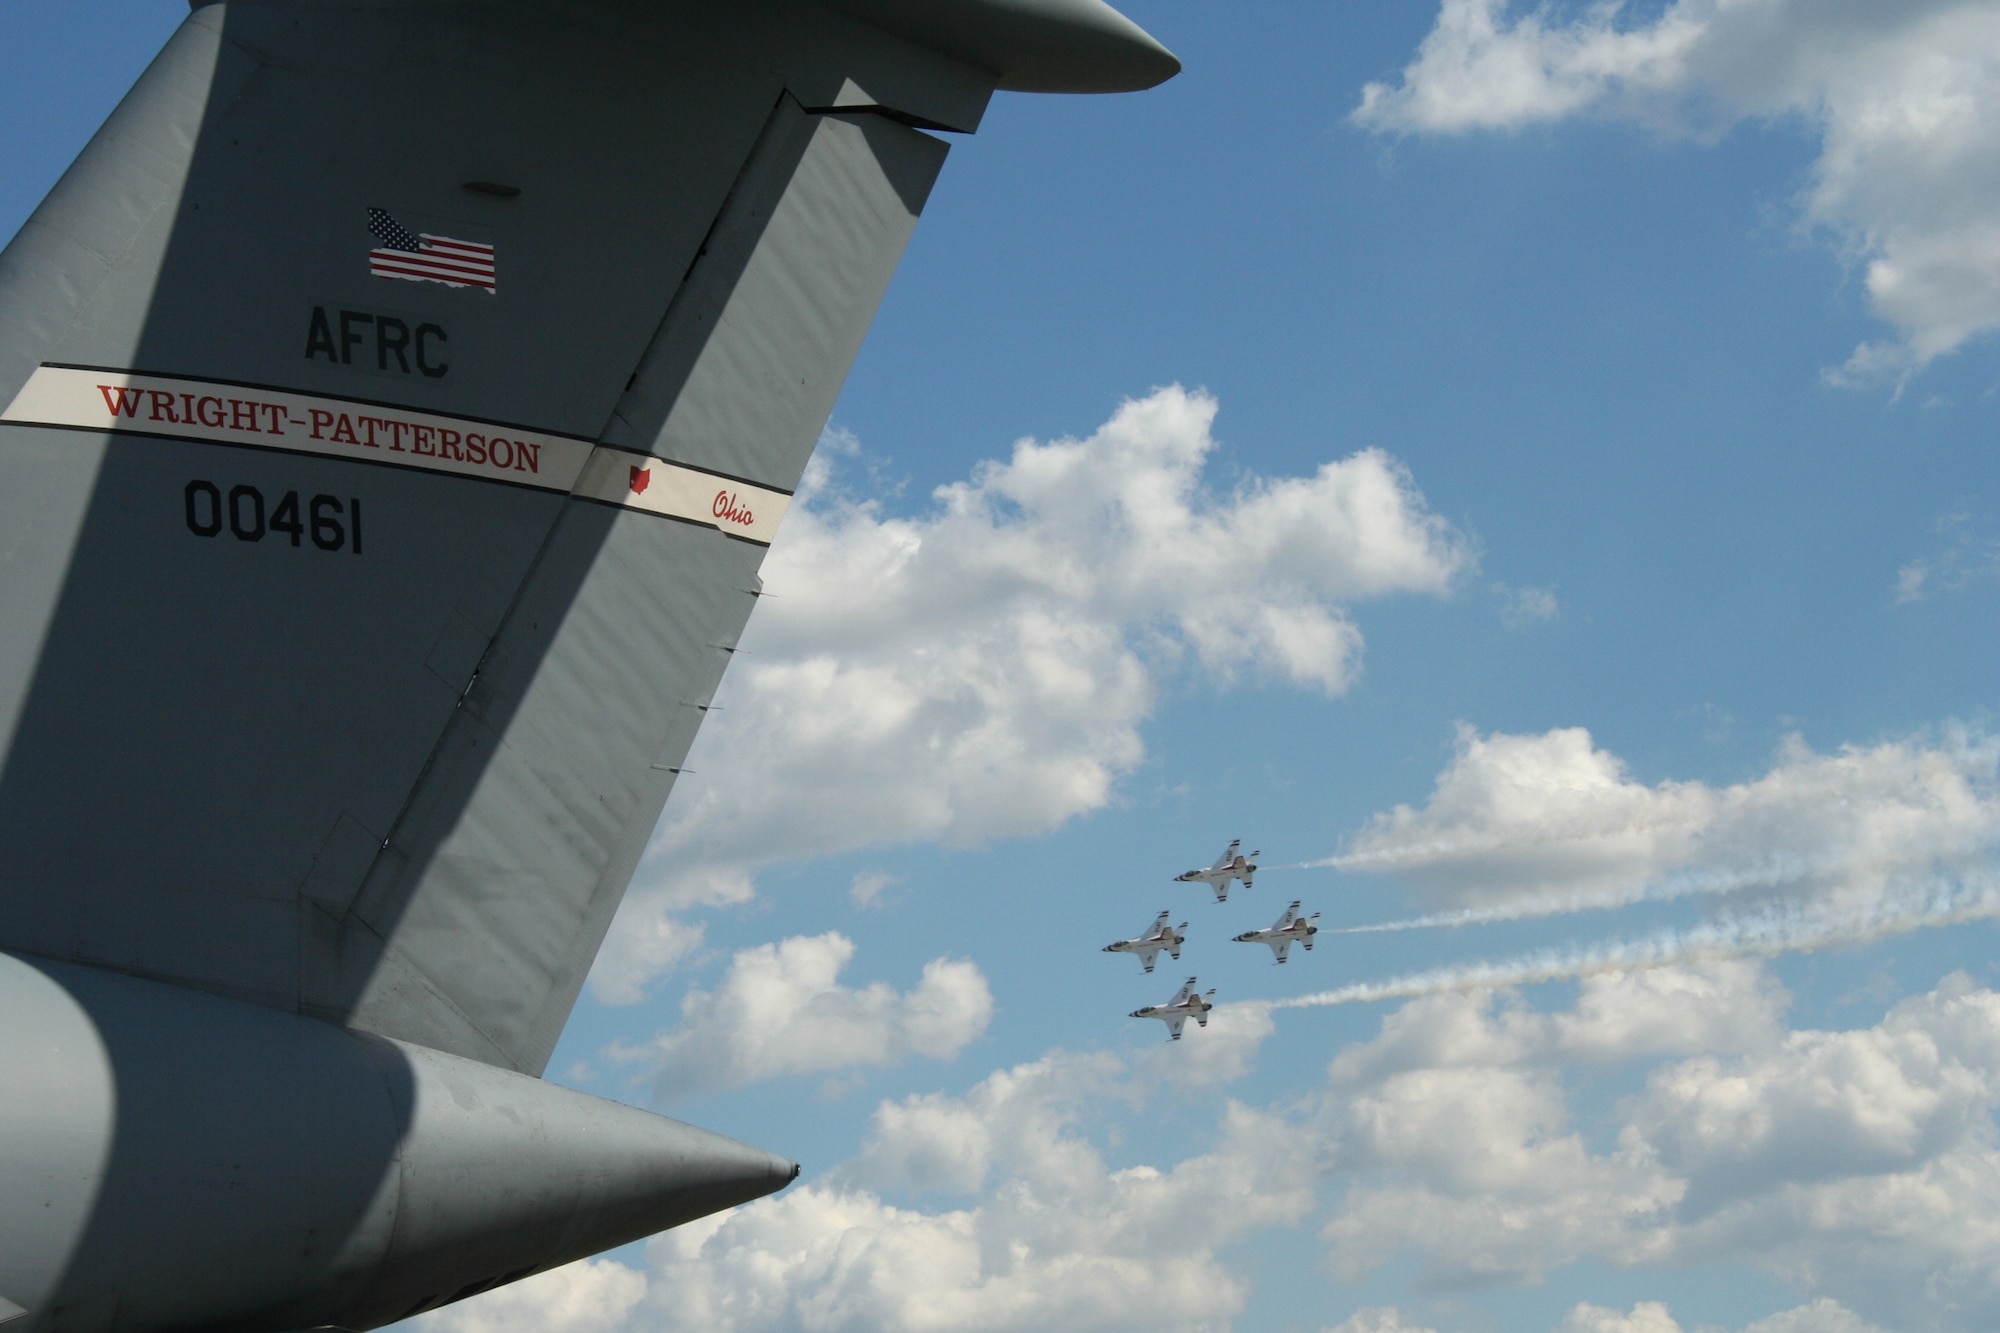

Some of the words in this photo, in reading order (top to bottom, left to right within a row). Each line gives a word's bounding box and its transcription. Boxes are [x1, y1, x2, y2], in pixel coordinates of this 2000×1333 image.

[305, 306, 449, 379] AFRC
[96, 384, 541, 474] WRIGHT-PATTERSON
[184, 479, 363, 555] 00461
[712, 490, 754, 526] Ohio
